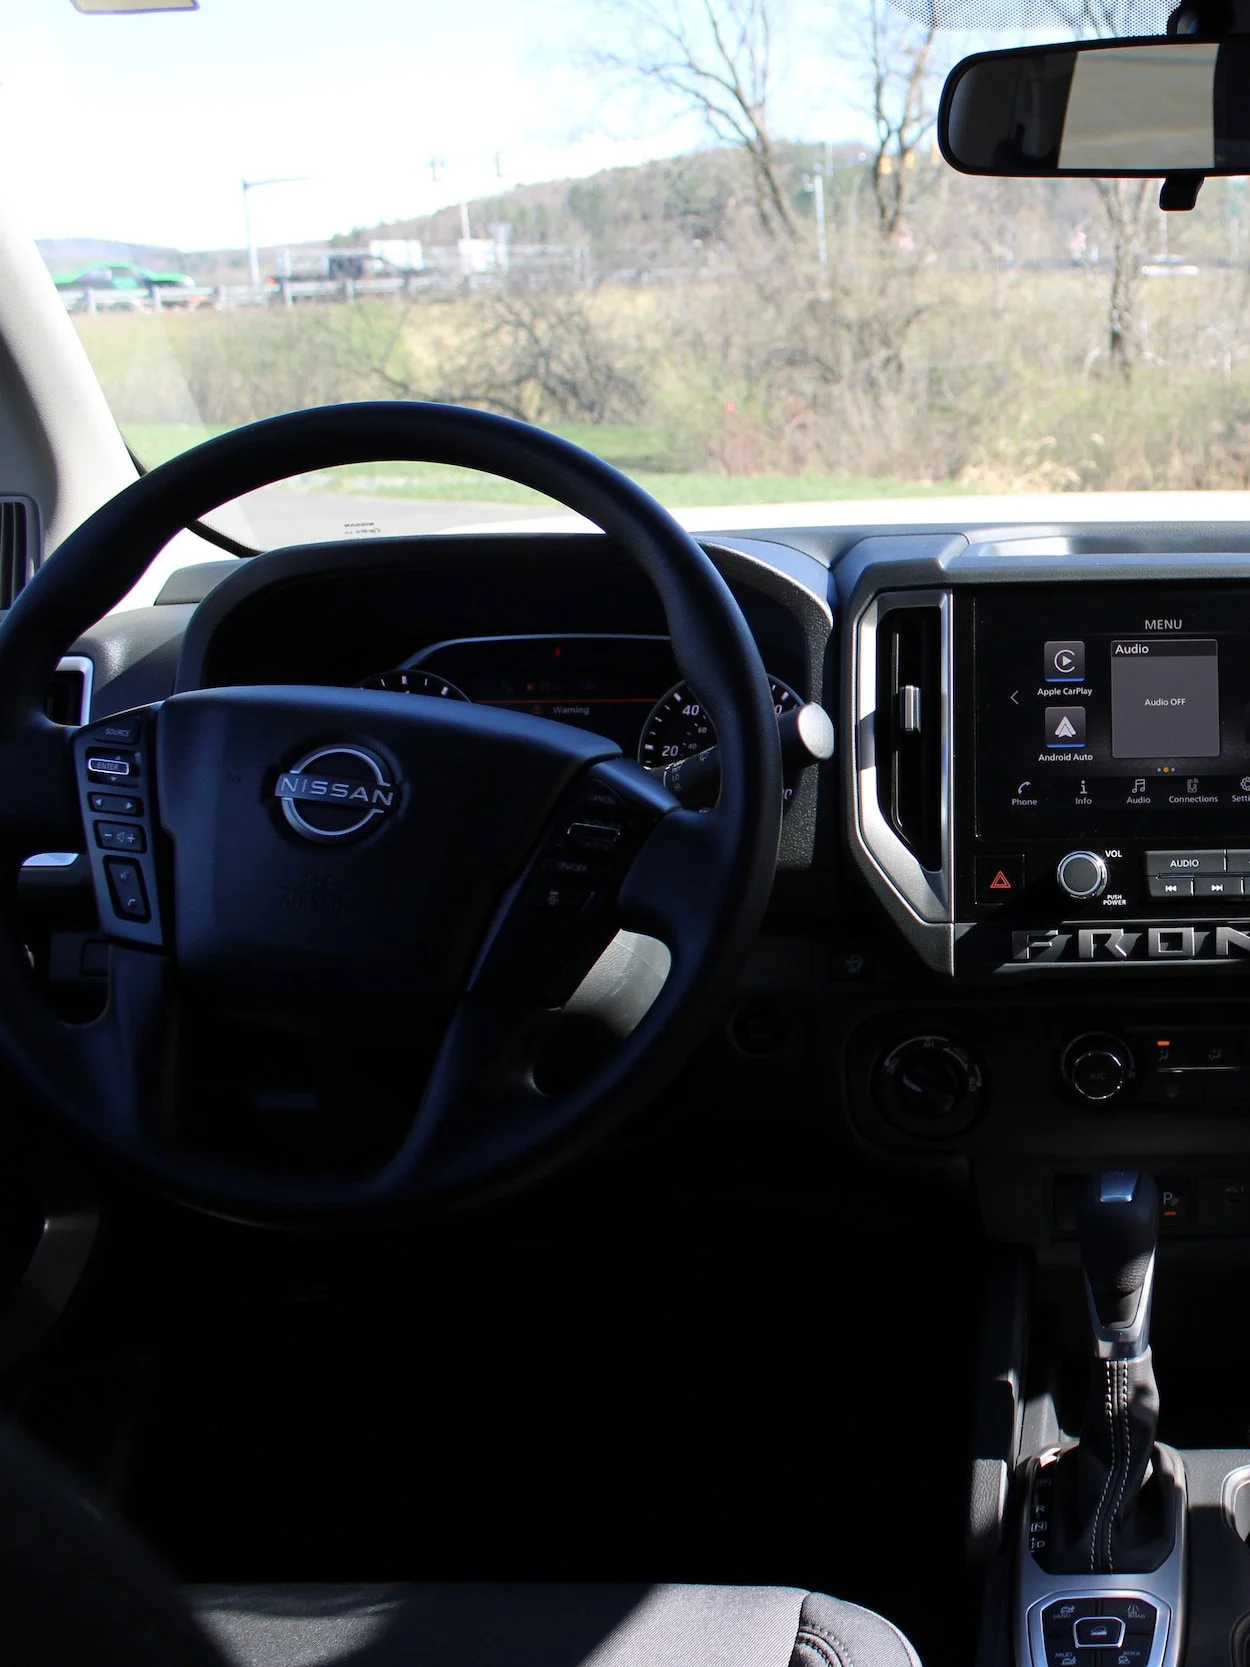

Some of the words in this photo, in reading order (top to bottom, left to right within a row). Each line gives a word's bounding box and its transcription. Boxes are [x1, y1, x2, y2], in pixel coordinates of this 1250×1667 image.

[1144, 619, 1183, 631] MENU
[1115, 644, 1149, 655] Audio
[1037, 687, 1060, 698] Apple
[1062, 686, 1093, 697] CarPlay
[1144, 698, 1168, 707] Audio
[1170, 698, 1186, 706] OFF
[552, 705, 590, 716] Warning
[682, 704, 700, 717] 40
[661, 745, 679, 757] 20
[1038, 752, 1070, 762] Android
[1072, 752, 1093, 762] Auto
[280, 777, 394, 806] NISSAN
[1011, 797, 1037, 808] Phone
[1075, 797, 1092, 805] Info
[1126, 796, 1151, 805] Audio
[1168, 795, 1218, 803] Connections
[1104, 850, 1123, 858] VOL
[1170, 858, 1199, 868] AUDIO
